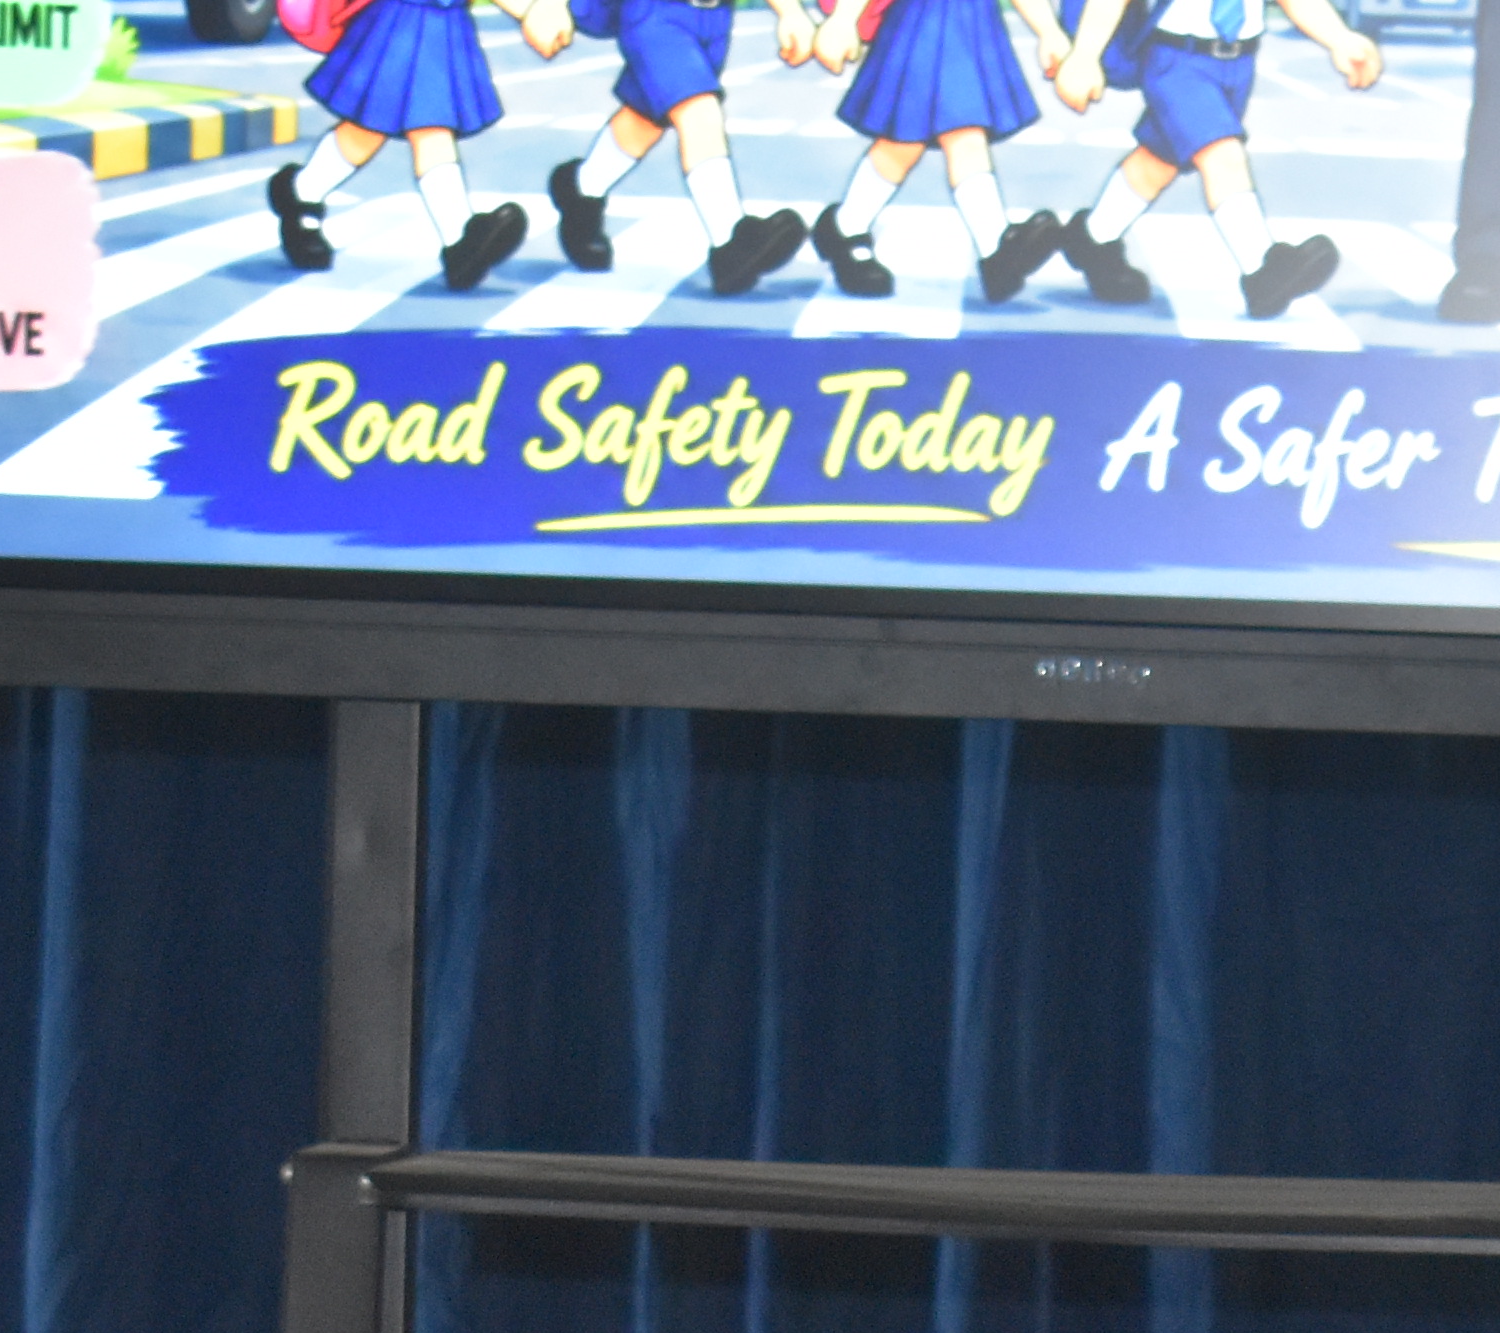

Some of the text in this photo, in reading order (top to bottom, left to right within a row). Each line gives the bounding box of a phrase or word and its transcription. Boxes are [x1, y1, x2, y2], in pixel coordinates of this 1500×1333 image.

[269, 360, 506, 480] Road
[523, 362, 791, 507] Safety
[819, 370, 1054, 518] Today
[1100, 380, 1183, 493] A
[1203, 384, 1442, 530] Safer
